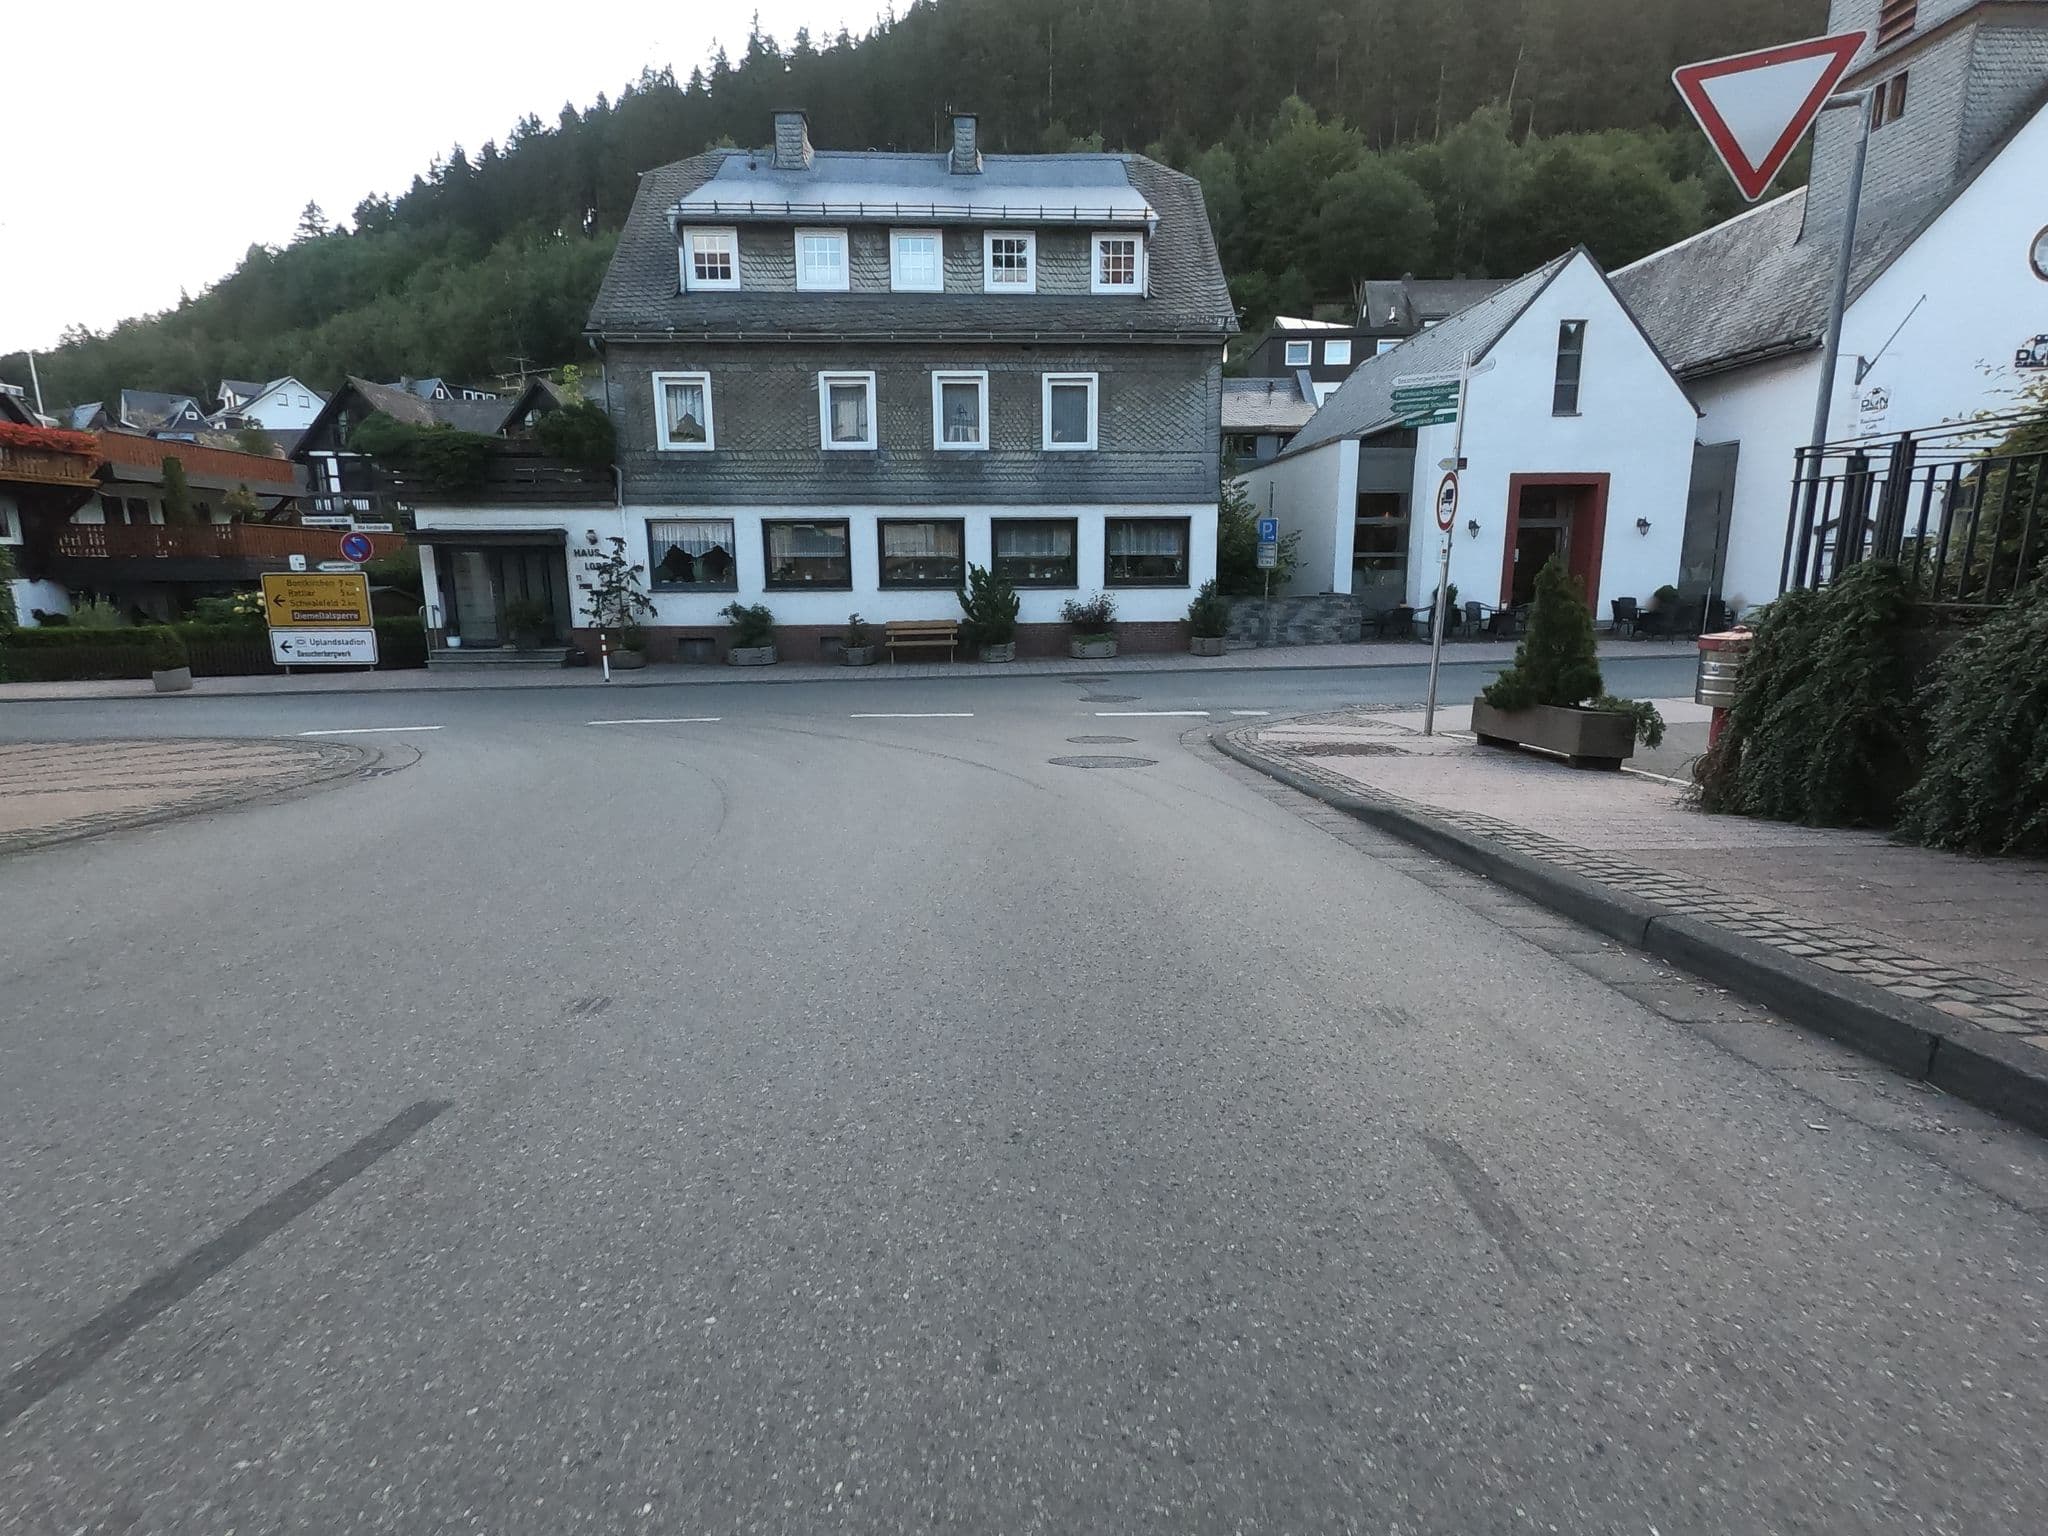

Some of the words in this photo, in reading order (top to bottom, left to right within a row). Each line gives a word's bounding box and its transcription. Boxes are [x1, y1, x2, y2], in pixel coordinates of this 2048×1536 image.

[2016, 349, 2048, 361] DO
[1861, 396, 1889, 408] DON
[1262, 522, 1273, 540] P
[574, 549, 600, 557] HAUS
[309, 638, 366, 647] Uplandstadion
